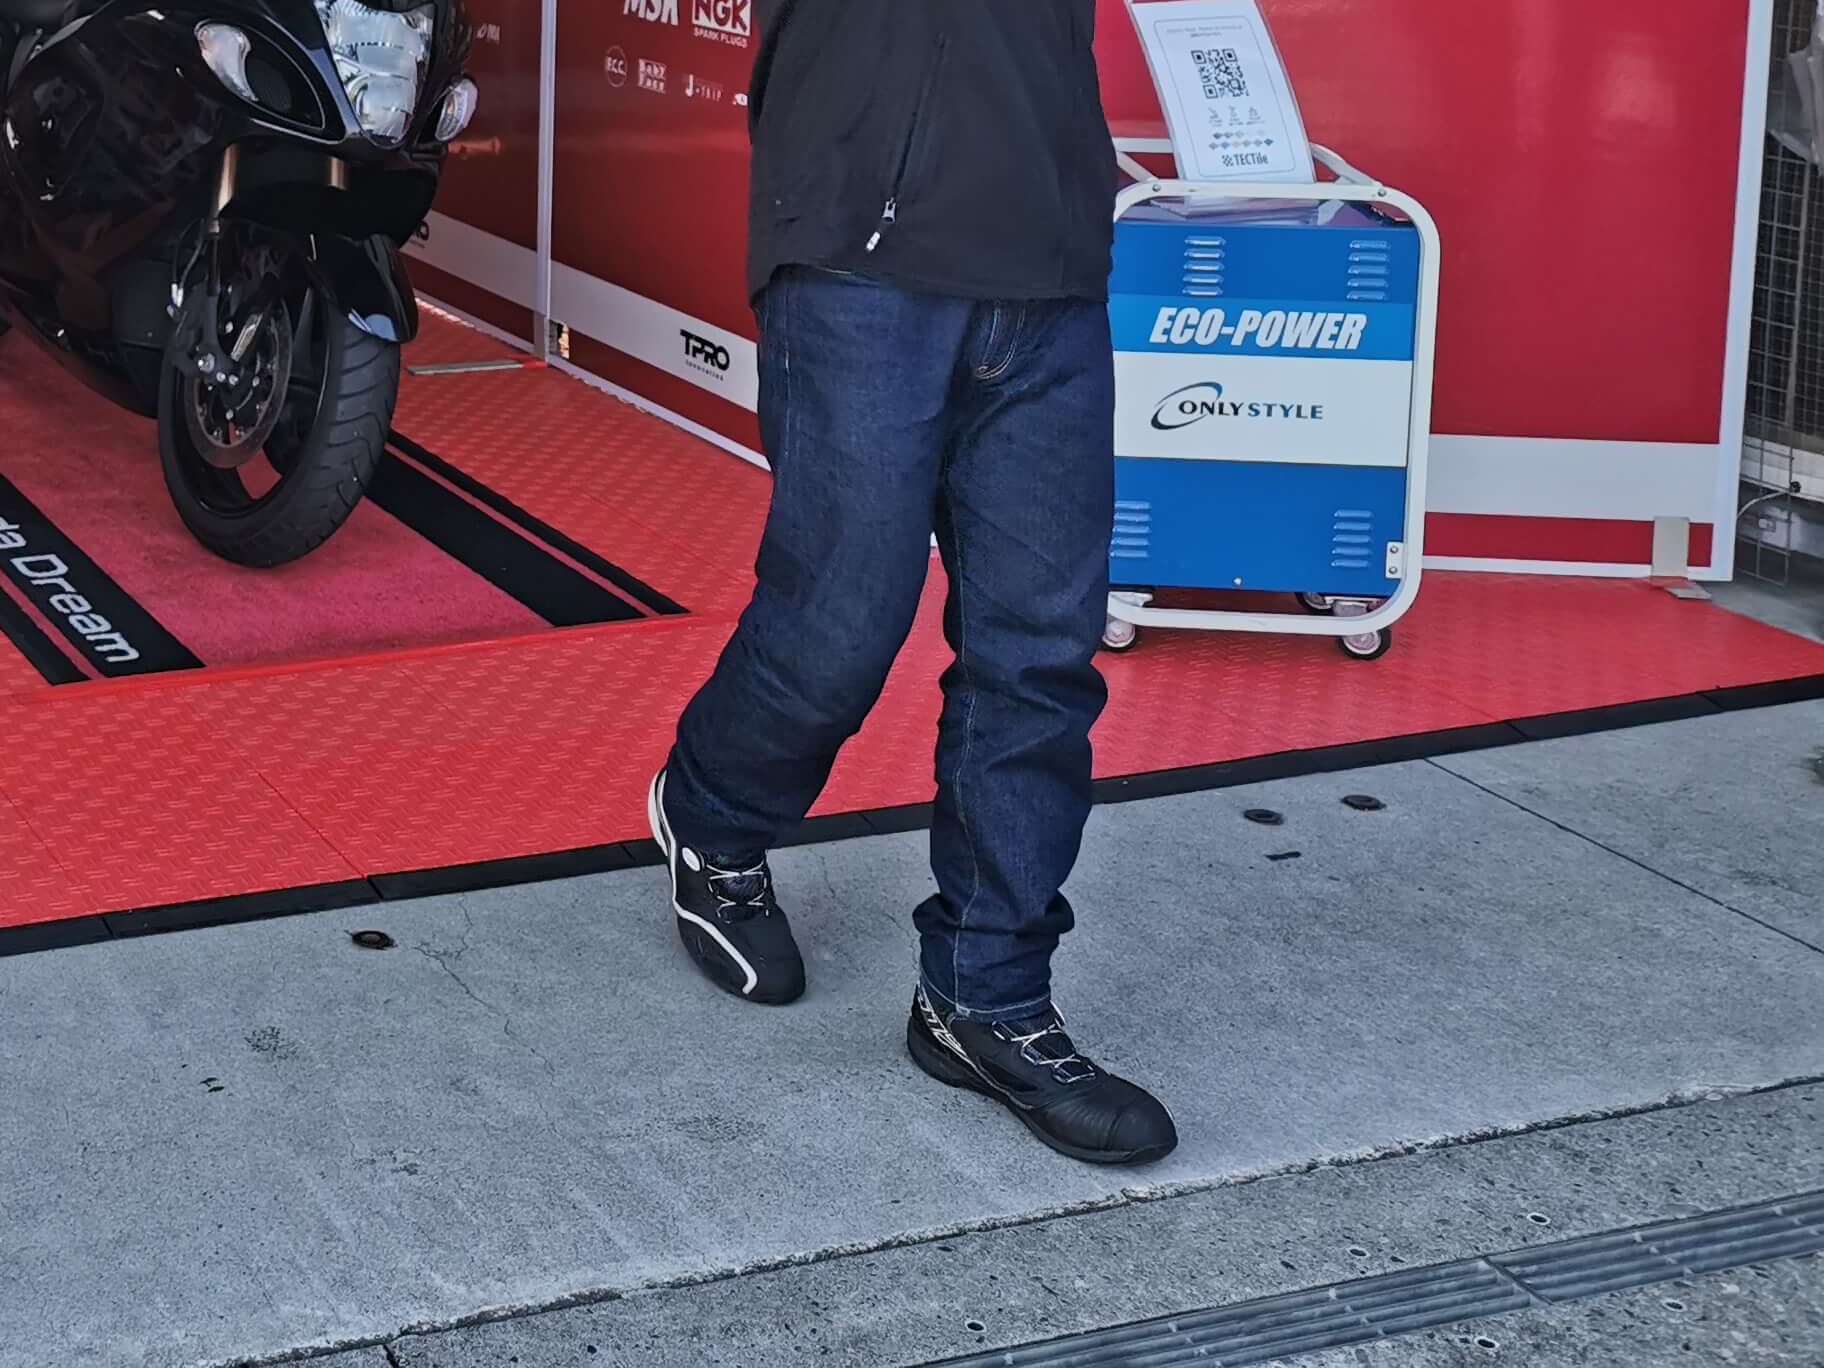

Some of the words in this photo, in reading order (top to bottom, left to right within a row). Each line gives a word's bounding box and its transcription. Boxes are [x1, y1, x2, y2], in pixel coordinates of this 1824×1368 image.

[680, 328, 730, 371] TPRO
[1149, 307, 1368, 350] ECO-POWER
[10, 553, 140, 663] Dream
